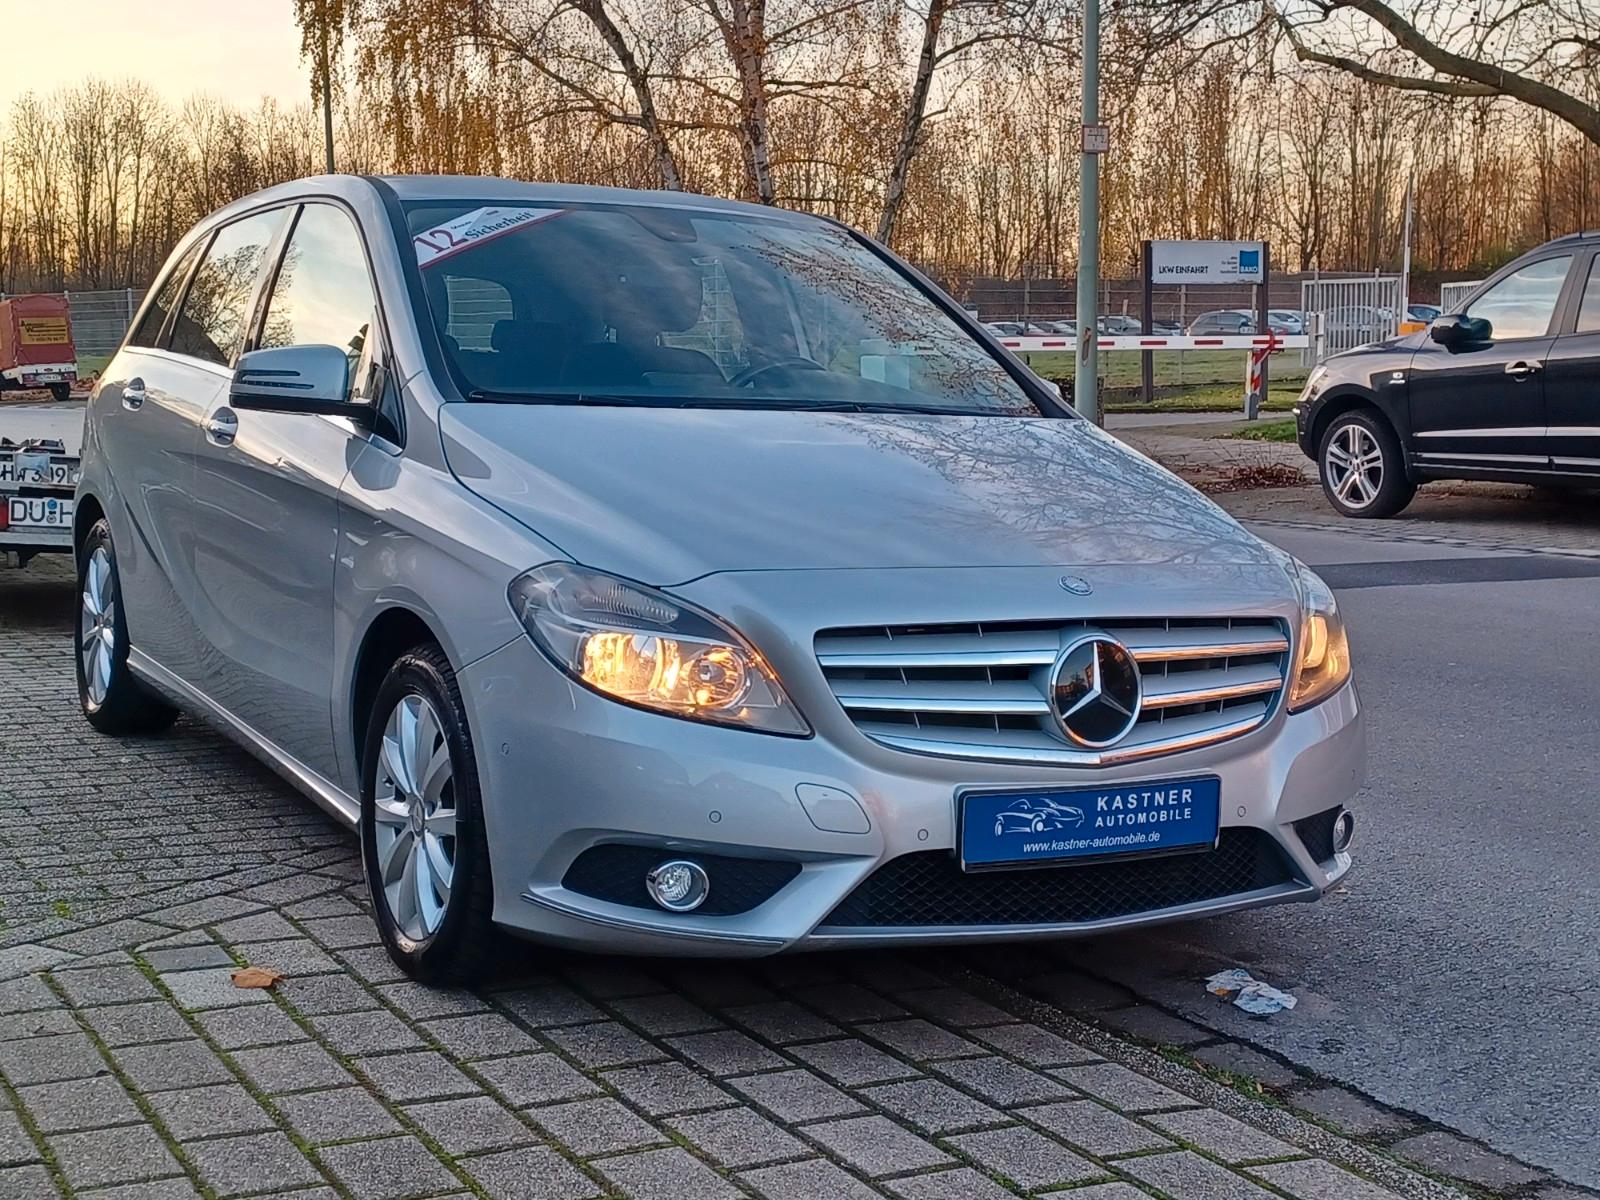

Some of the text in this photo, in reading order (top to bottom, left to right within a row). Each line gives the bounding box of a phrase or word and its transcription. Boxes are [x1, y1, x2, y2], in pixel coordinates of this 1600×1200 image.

[465, 211, 535, 238] Sicherheit
[413, 228, 468, 254] 12
[1159, 265, 1175, 274] LKW
[1175, 265, 1209, 275] EINFAHRT
[10, 500, 45, 523] DU
[1097, 788, 1193, 812] KASTNER
[1095, 807, 1192, 828] AUTOMOBILE
[1023, 831, 1161, 853] www.kastner-automobile.de
